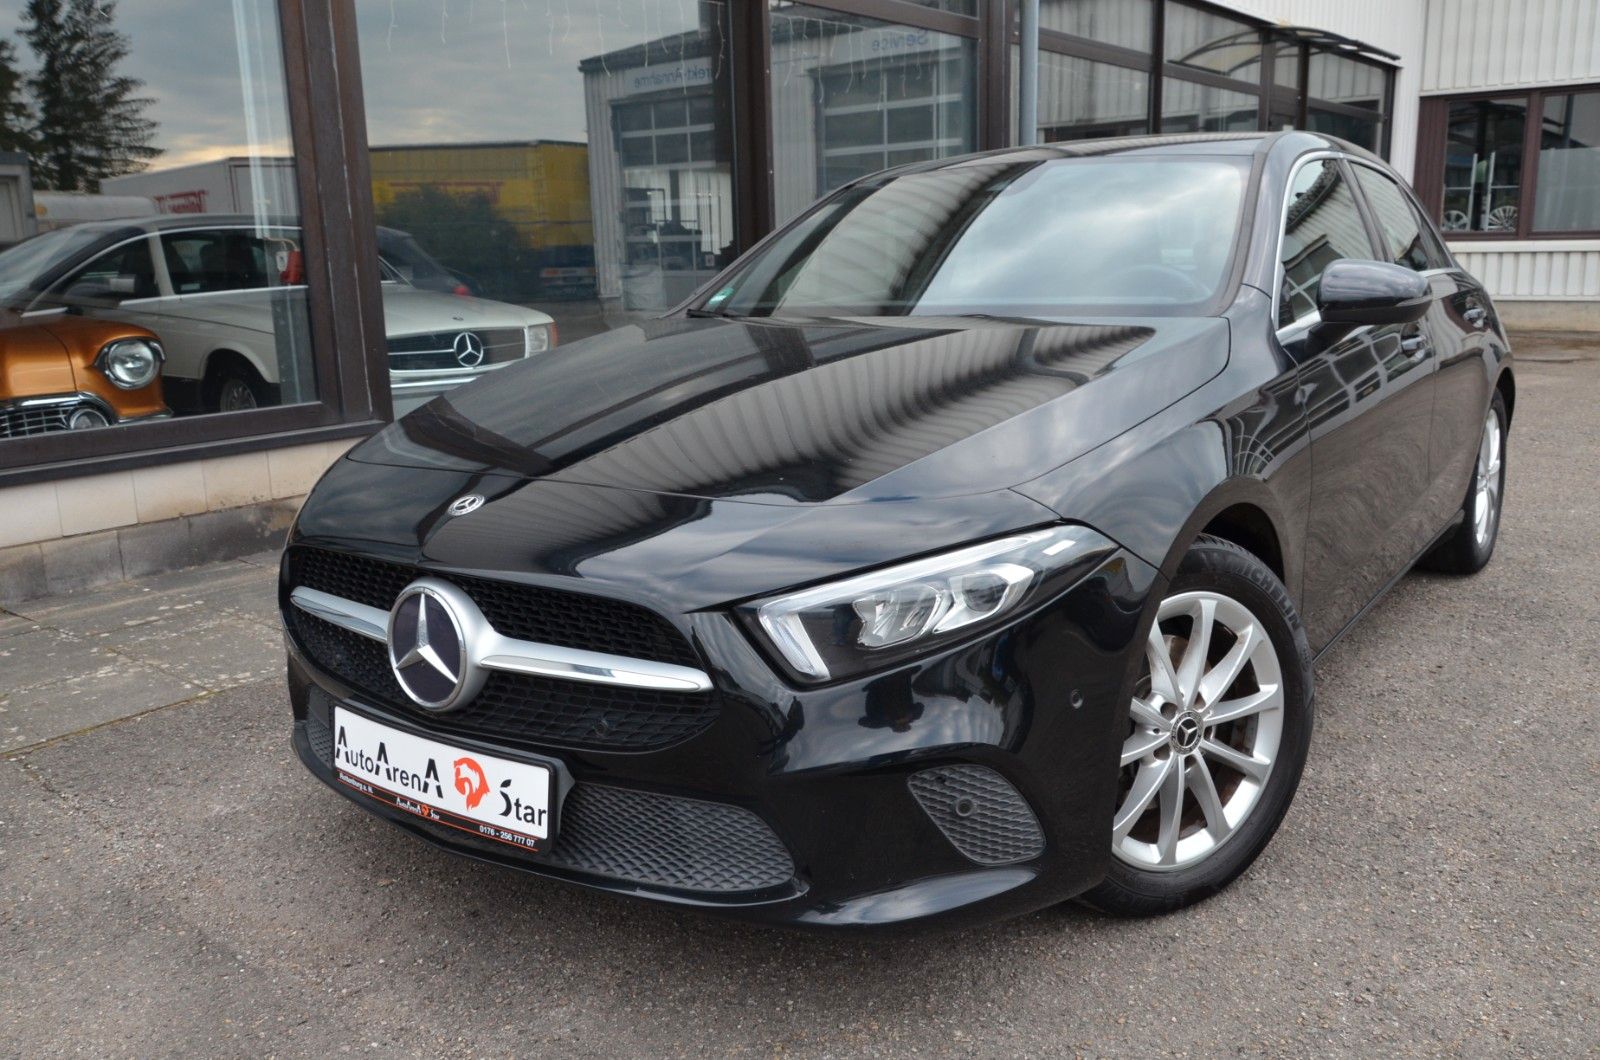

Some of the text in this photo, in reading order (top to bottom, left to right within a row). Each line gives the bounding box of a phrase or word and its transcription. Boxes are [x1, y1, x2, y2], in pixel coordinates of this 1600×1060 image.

[335, 725, 547, 826] AutoArenA Star
[479, 825, 495, 836] 0176
[513, 834, 526, 845] 777
[526, 838, 535, 848] 07
